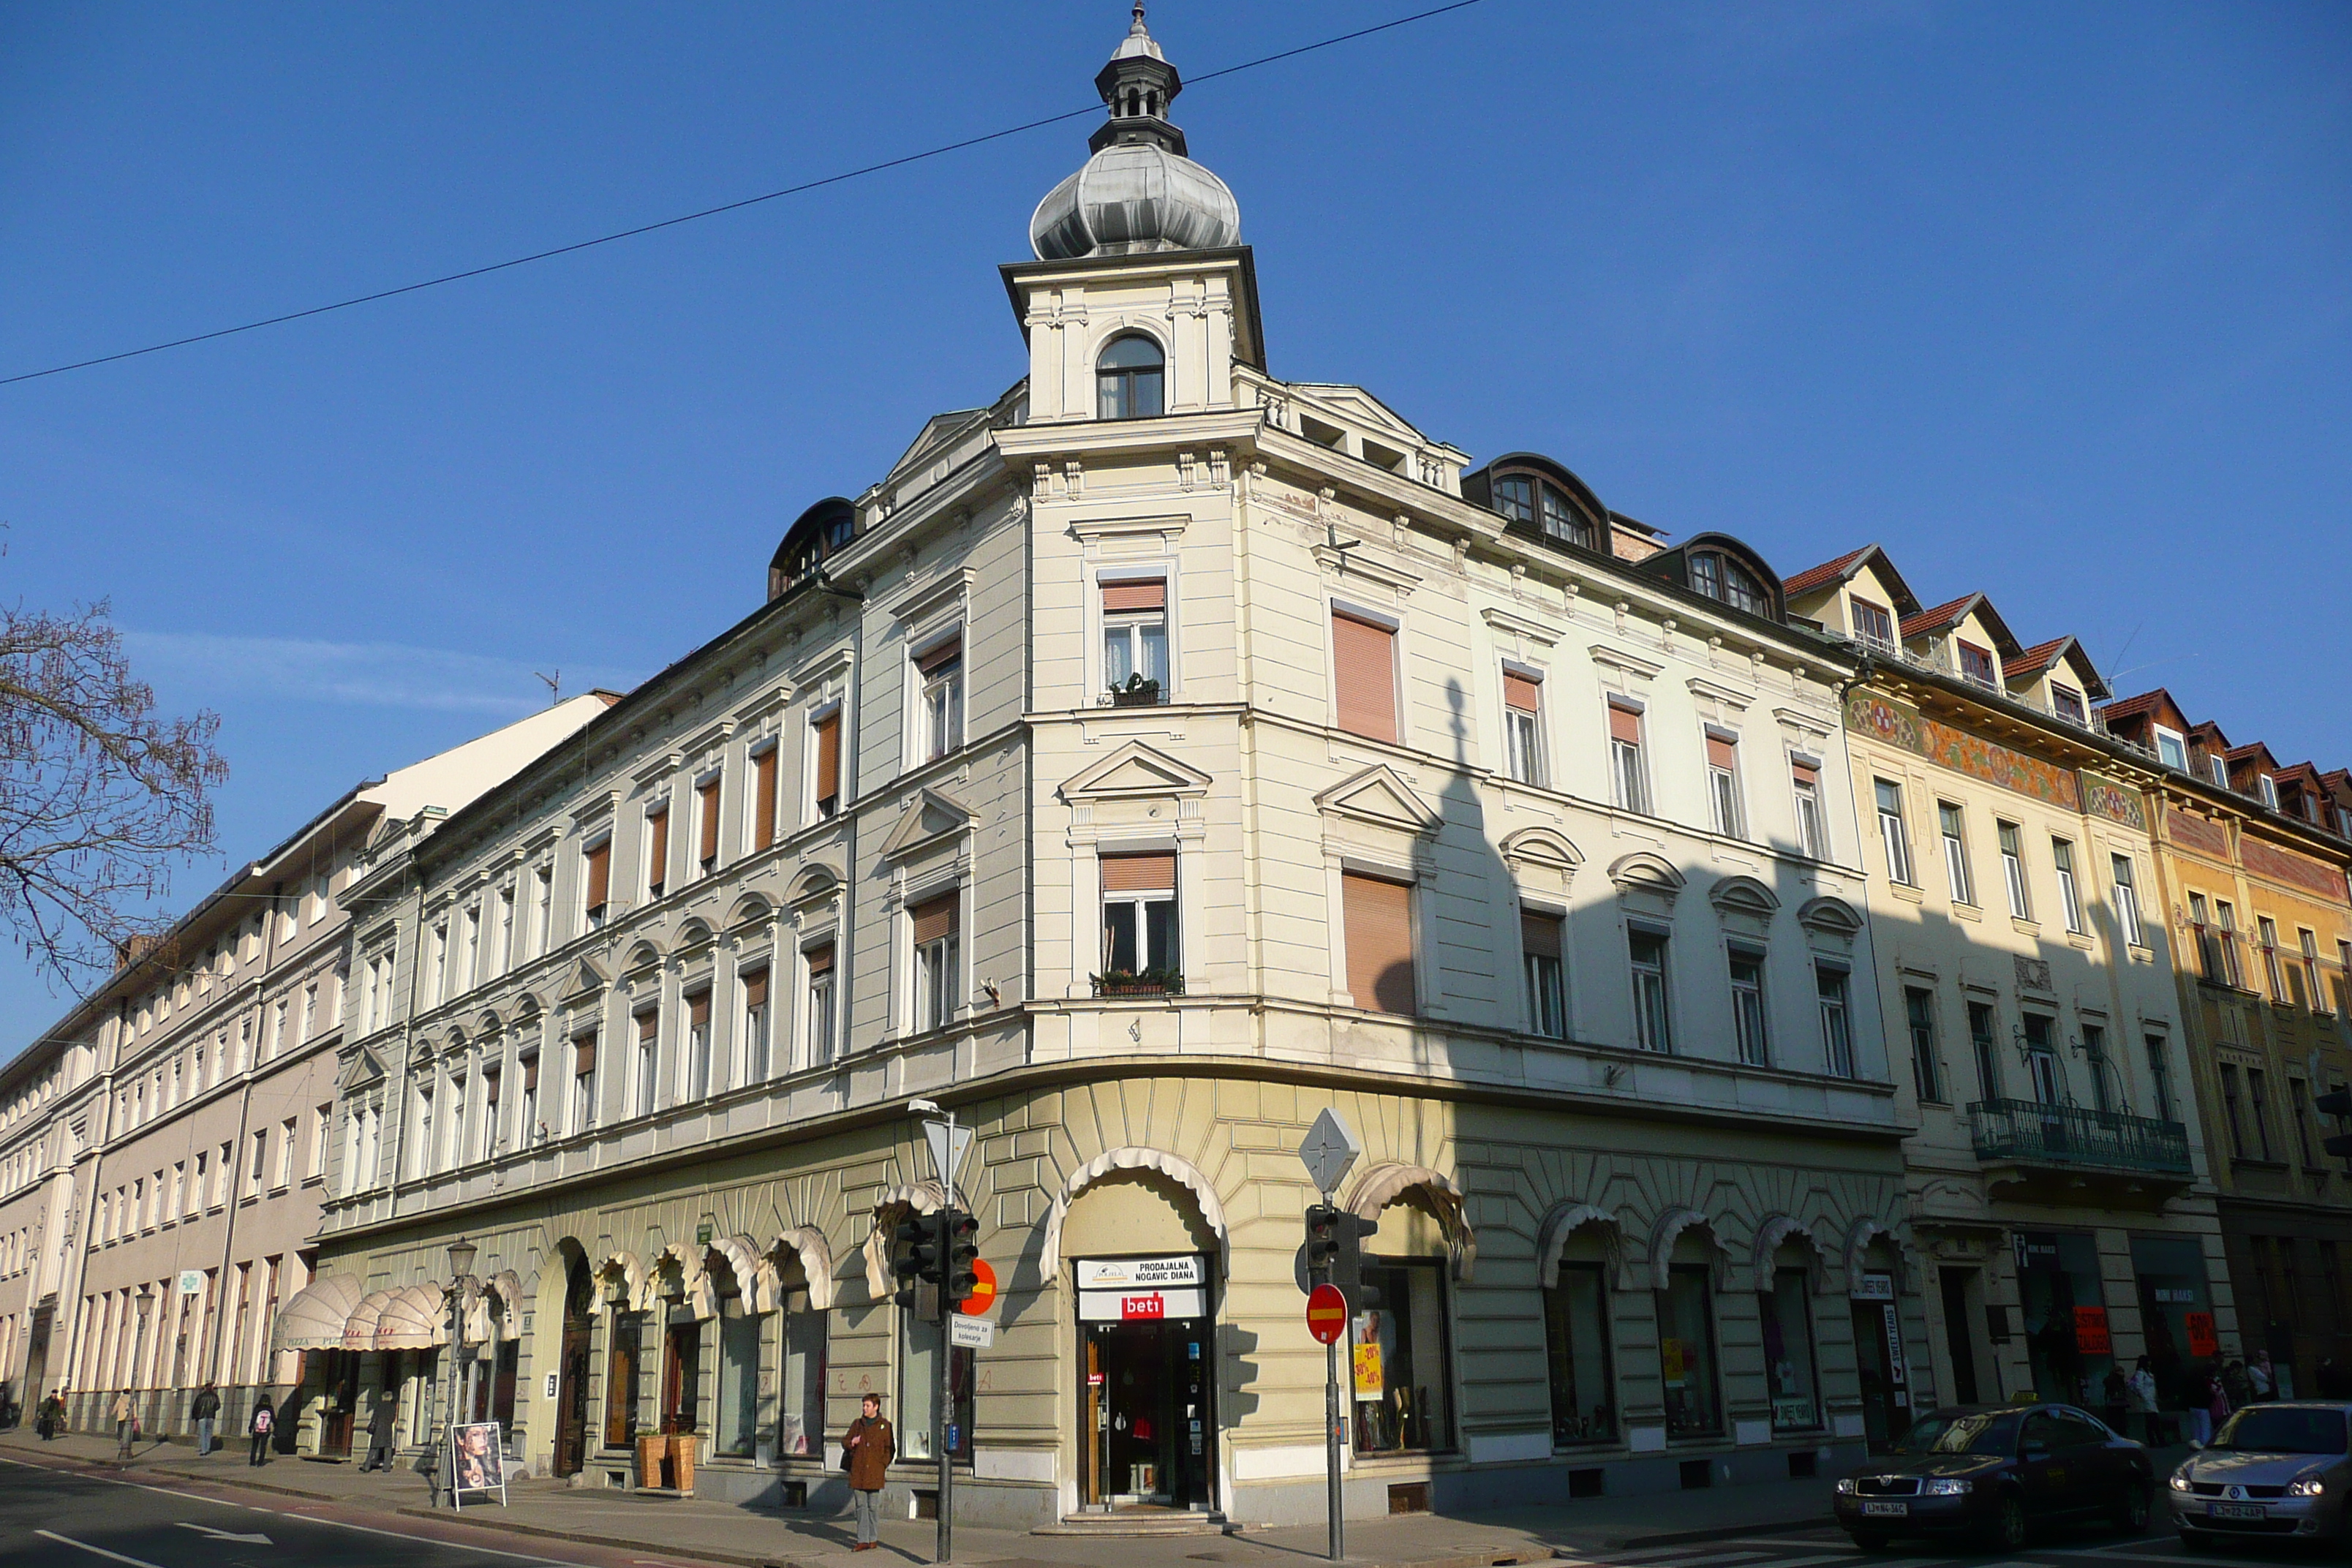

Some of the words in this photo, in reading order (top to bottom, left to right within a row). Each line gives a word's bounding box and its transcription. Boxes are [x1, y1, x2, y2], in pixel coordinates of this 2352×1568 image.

[1139, 1262, 1190, 1272] PRODAJALNA
[1135, 1272, 1168, 1282] NOGAVIC
[1171, 1270, 1195, 1281] DIANA
[2155, 1289, 2171, 1302] MINI
[2171, 1289, 2194, 1302] MAKSI
[1127, 1297, 1159, 1313] beti
[954, 1321, 980, 1331] Dovoljeno
[1886, 1310, 1897, 1334] YEARS
[287, 1338, 309, 1346] PIZZA
[958, 1332, 981, 1343] kolesarje
[1365, 1346, 1379, 1360] -20%
[1889, 1335, 1900, 1362] SWEET
[1365, 1371, 1380, 1385] -40%
[1866, 1503, 1875, 1513] LJ
[2214, 1506, 2225, 1516] LJ
